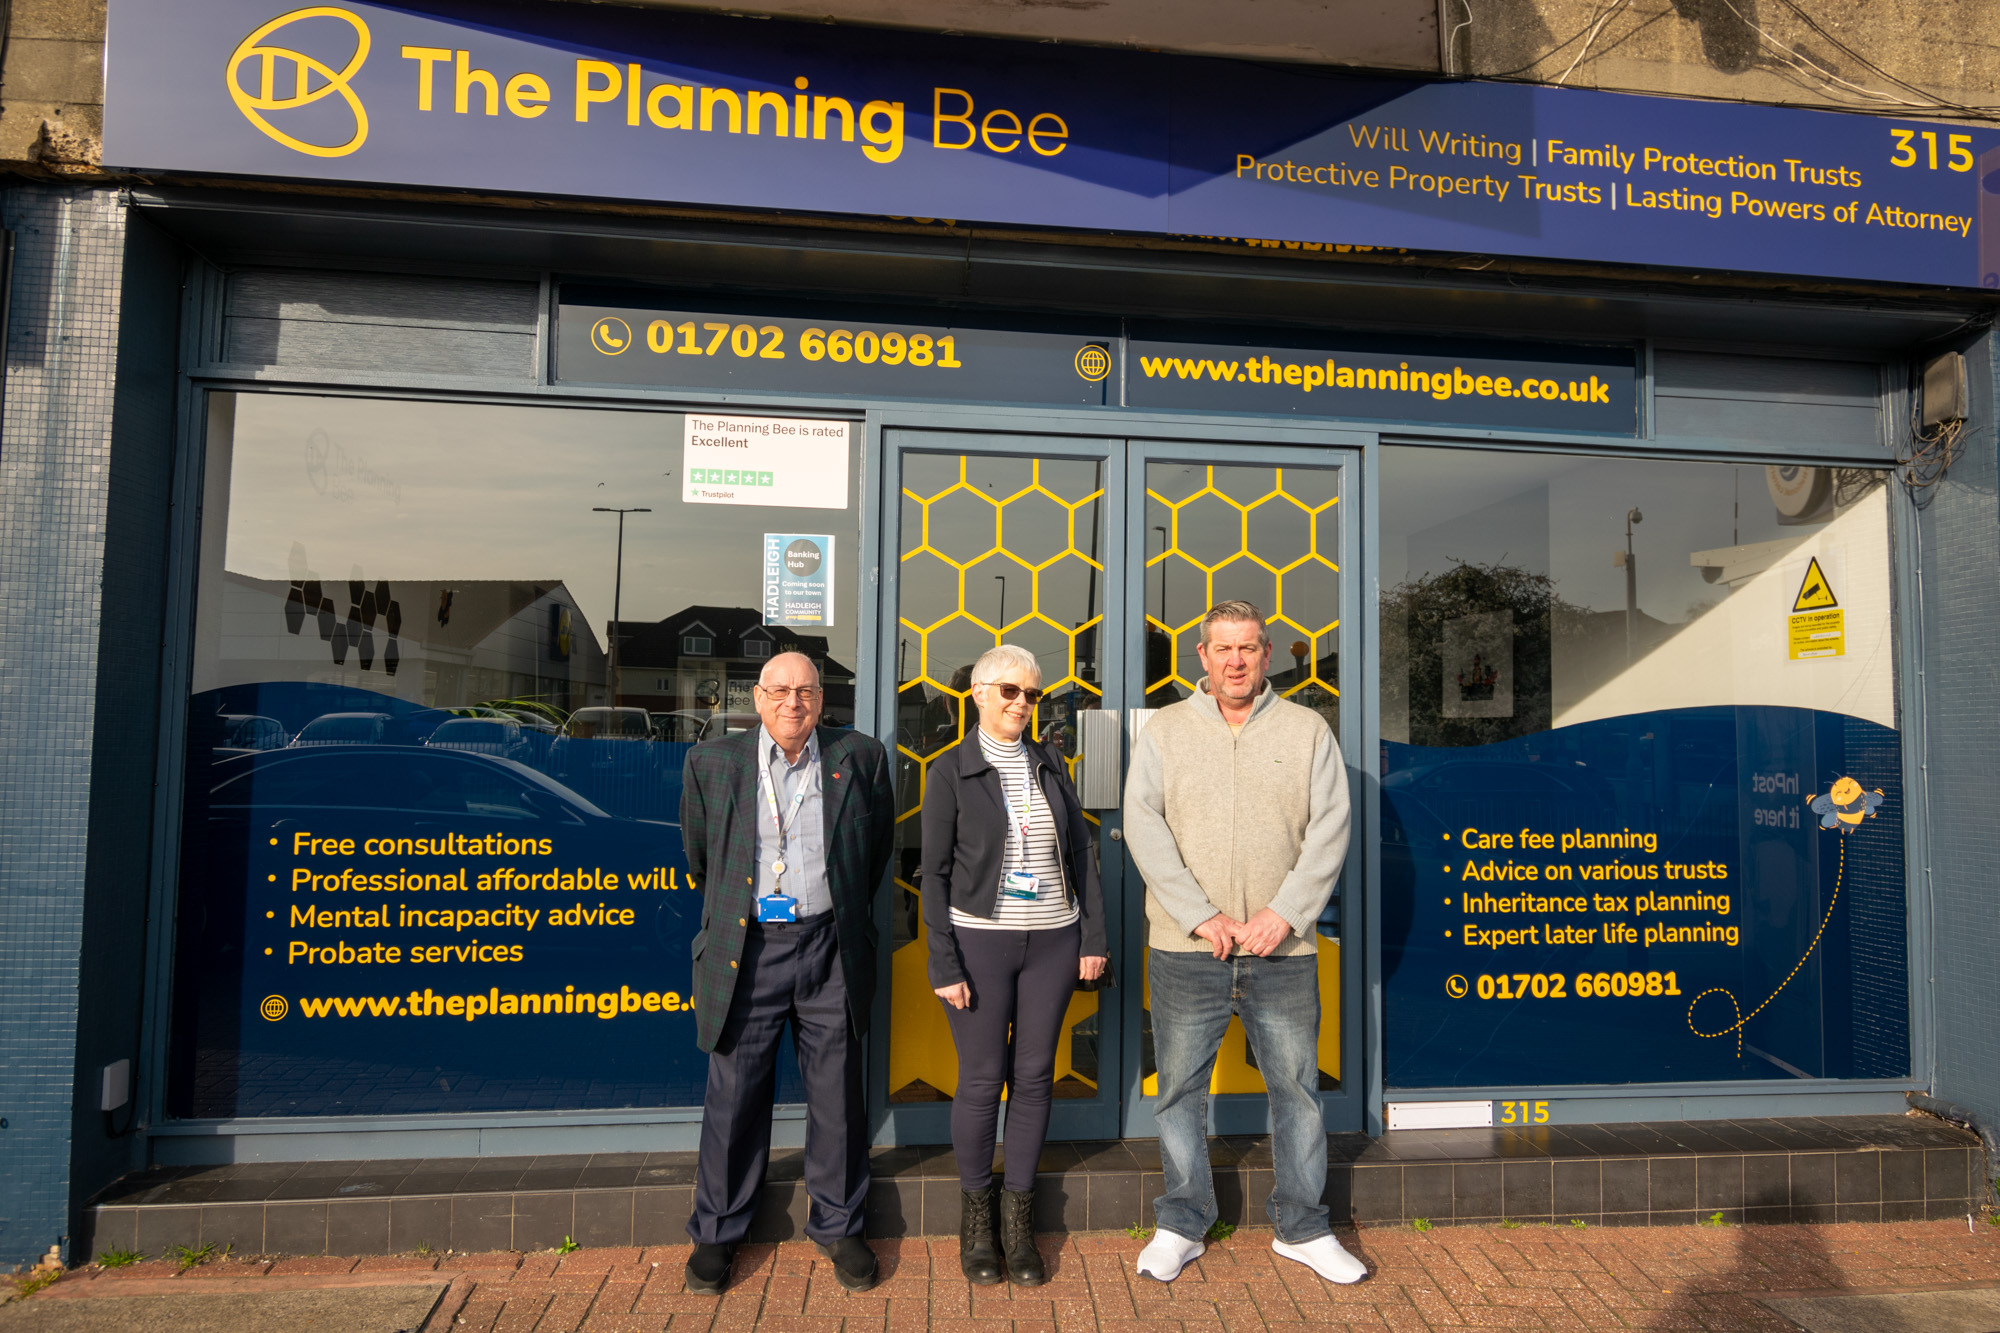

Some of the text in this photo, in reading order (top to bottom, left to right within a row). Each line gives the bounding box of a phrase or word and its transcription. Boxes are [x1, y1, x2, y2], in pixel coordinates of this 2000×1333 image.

[401, 45, 1069, 163] The Planning Bee
[1348, 123, 1862, 188] Will Writing Family Protection Trusts
[1890, 128, 1974, 173] 315
[1236, 153, 1973, 238] Protective Property Trusts Lasting Powers of Attorney
[647, 320, 962, 368] 01702 660981
[1139, 354, 1610, 403] www.theplanningbee.co.uk
[692, 419, 844, 437] The Planning Bee is rated
[691, 436, 749, 448] Excellent
[702, 490, 734, 499] Trustpilot
[787, 551, 820, 560] Banking
[766, 538, 780, 618] HADLEIGH
[1791, 616, 1807, 624] CCTV
[1813, 613, 1840, 622] operation
[294, 832, 553, 856] Free consultations
[1461, 827, 1658, 854] Care fee planning
[291, 868, 469, 892] Professional
[476, 867, 619, 891] affordable
[626, 867, 679, 890] will
[1461, 859, 1728, 882] Advice on various trusts
[290, 902, 635, 932] Mental incapacity advice
[1463, 890, 1731, 917] Inheritance tax planning
[1463, 921, 1740, 949] Expert later life planning
[288, 939, 524, 965] Probate services
[1476, 971, 1682, 1000] 01702 660981
[300, 985, 695, 1022] www.theplanningbee.
[1500, 1101, 1550, 1124] 315
